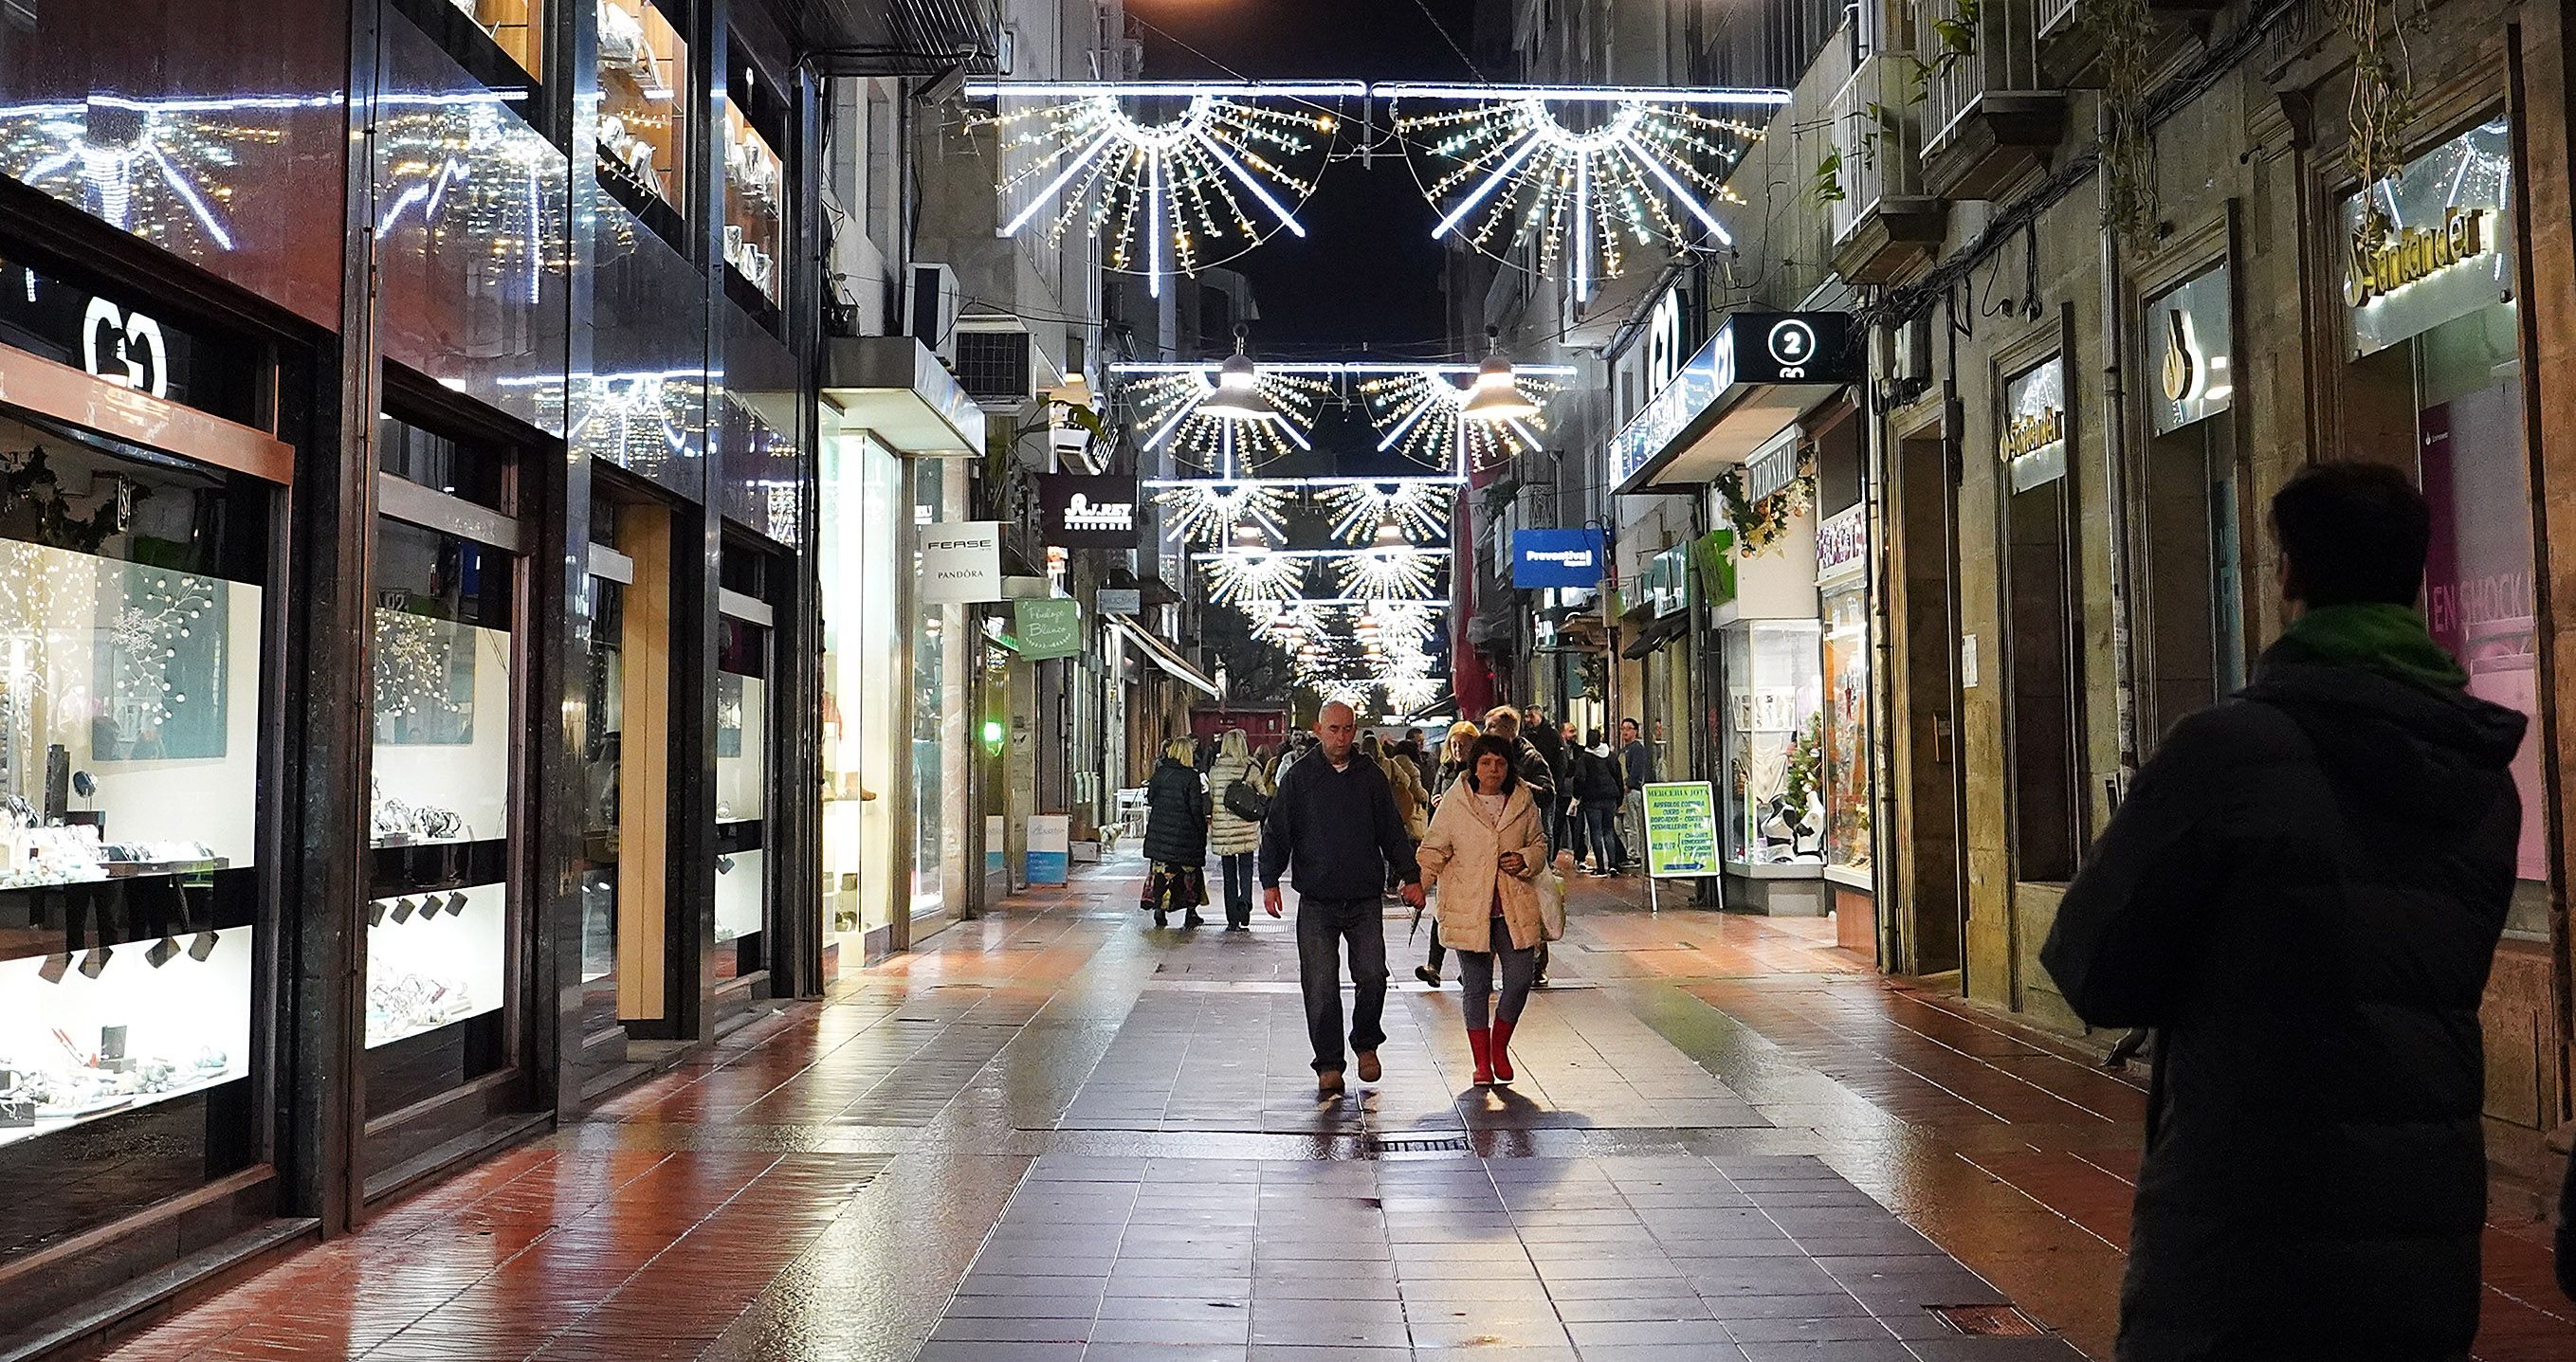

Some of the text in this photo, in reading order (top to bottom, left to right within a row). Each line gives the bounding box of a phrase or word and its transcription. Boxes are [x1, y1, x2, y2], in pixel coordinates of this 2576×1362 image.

[1783, 331, 1800, 354] 2
[928, 539, 992, 551] FEASE
[1526, 550, 1586, 561] Preventiva
[2433, 585, 2457, 632] EN
